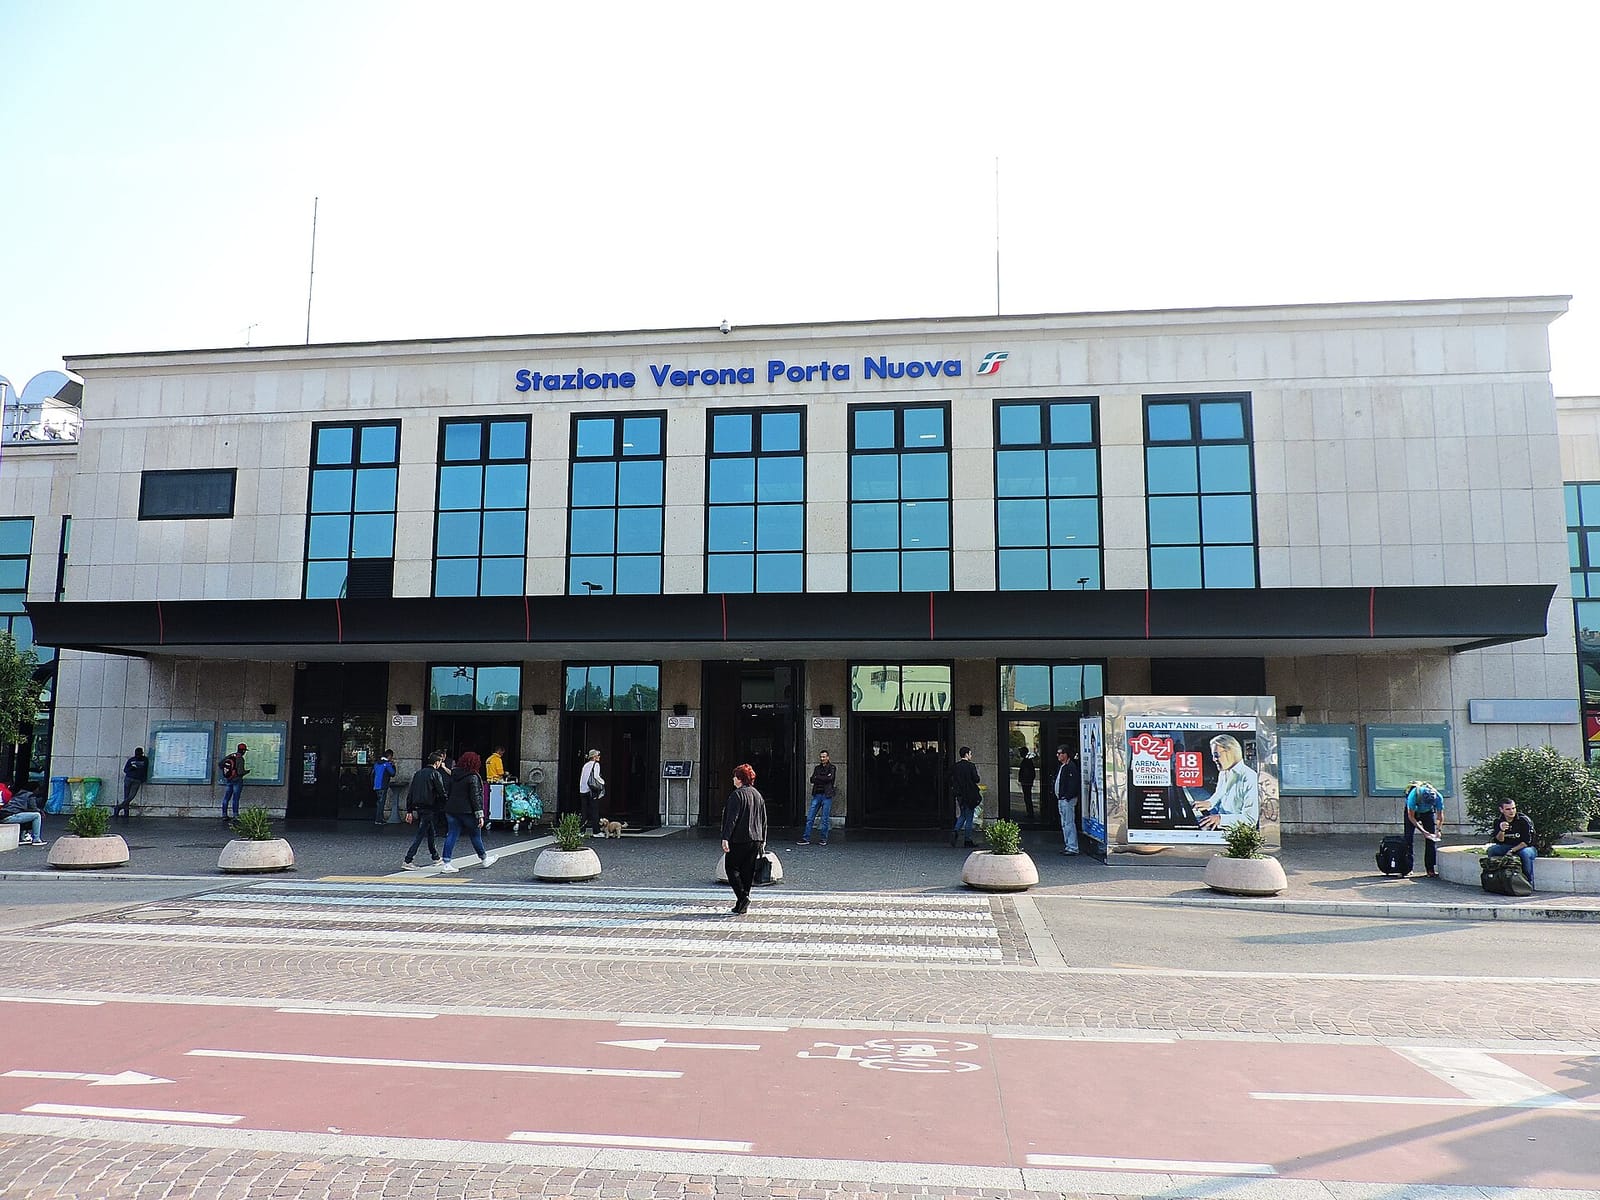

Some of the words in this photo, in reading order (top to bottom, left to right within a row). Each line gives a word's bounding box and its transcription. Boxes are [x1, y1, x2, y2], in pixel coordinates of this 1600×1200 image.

[515, 367, 636, 393] Stazione
[649, 364, 755, 387] Verona
[768, 360, 850, 383] Porta
[863, 356, 962, 380] Nuova
[1128, 721, 1199, 730] QUARANT'ANNI
[1130, 736, 1171, 759] TOZZI
[1179, 754, 1197, 767] 18
